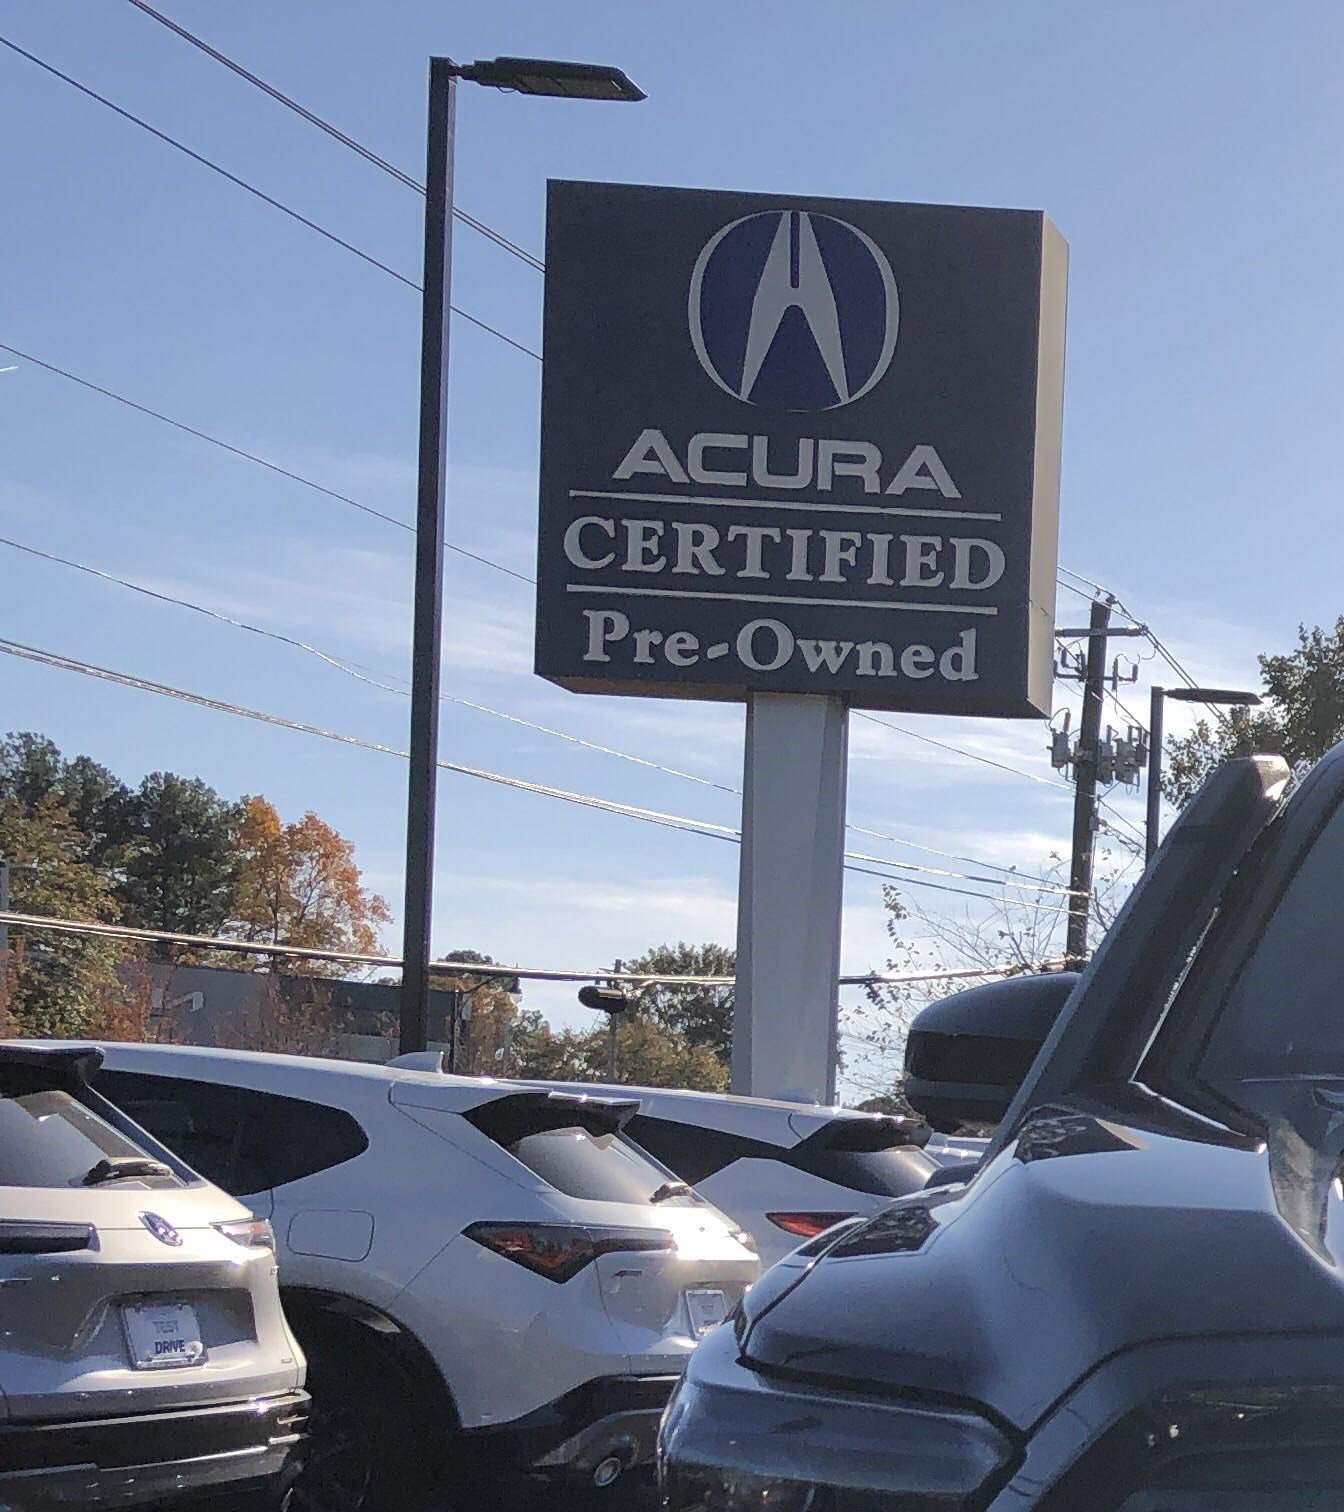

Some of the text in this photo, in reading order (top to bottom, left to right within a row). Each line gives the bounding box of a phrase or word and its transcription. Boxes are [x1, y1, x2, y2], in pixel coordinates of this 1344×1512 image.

[612, 429, 963, 499] ACURA
[563, 516, 1006, 591] CERTIFIED
[582, 608, 980, 682] Pre-Owned
[155, 1340, 186, 1354] DRIVE
